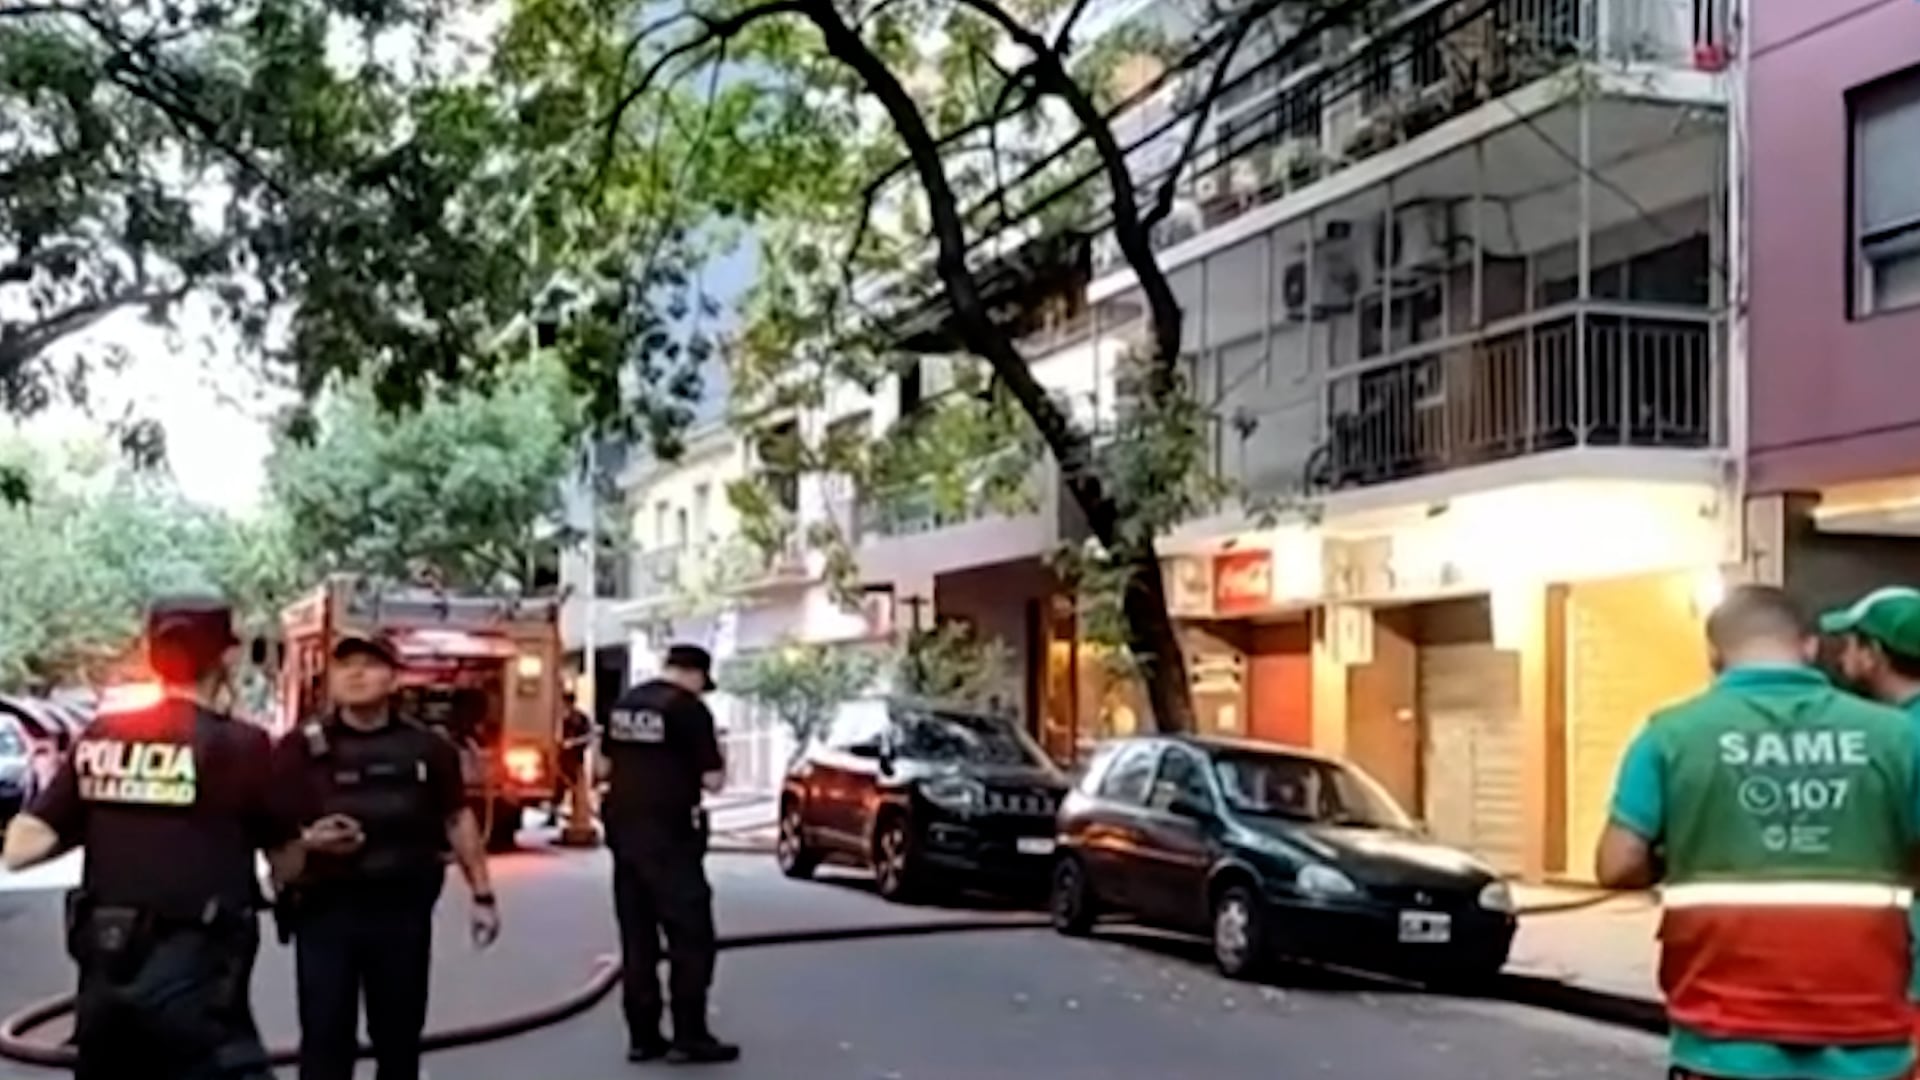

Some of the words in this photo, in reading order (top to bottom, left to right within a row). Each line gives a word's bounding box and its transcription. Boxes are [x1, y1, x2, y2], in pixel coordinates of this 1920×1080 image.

[75, 740, 196, 780] POLICIA
[1719, 731, 1868, 766] SAME
[1787, 778, 1848, 810] 107
